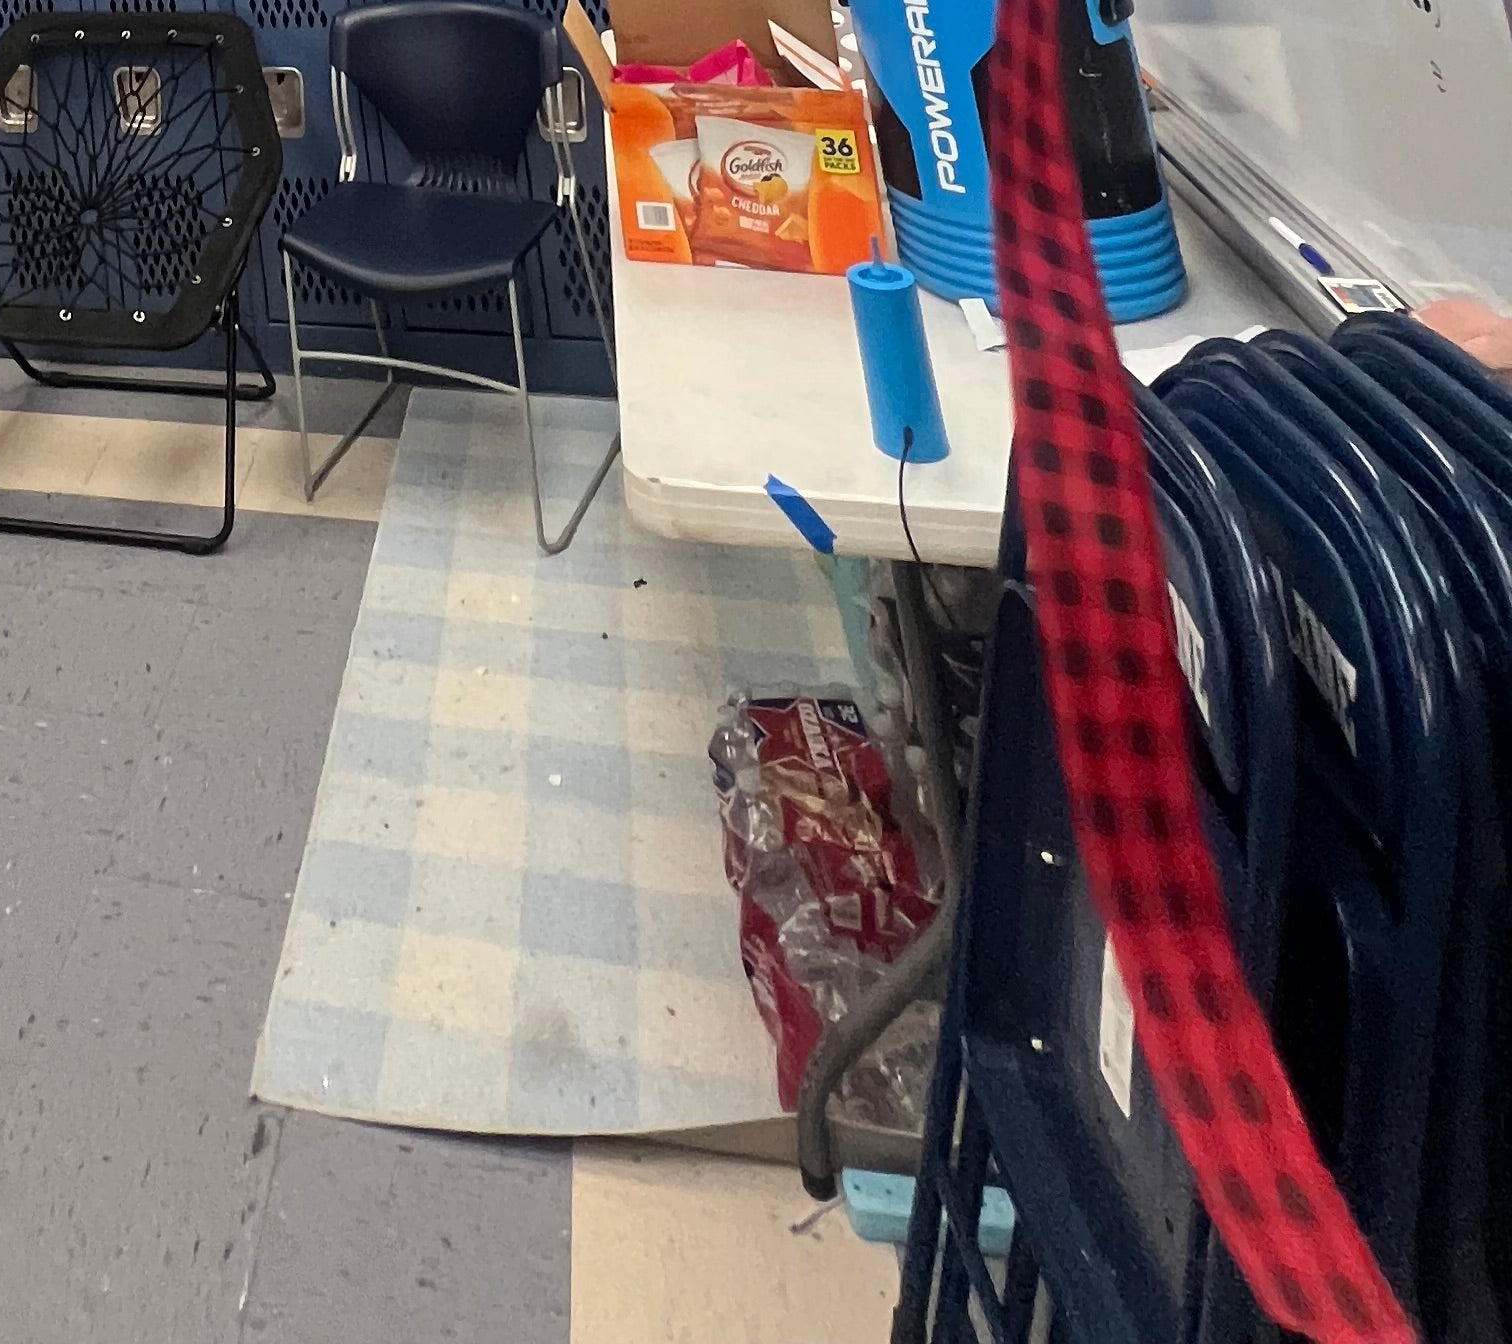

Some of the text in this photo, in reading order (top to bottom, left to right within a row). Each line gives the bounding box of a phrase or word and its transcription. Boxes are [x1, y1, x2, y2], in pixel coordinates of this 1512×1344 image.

[821, 137, 853, 156] 36
[730, 156, 783, 174] Goldfish
[731, 196, 780, 216] CHEDDAR
